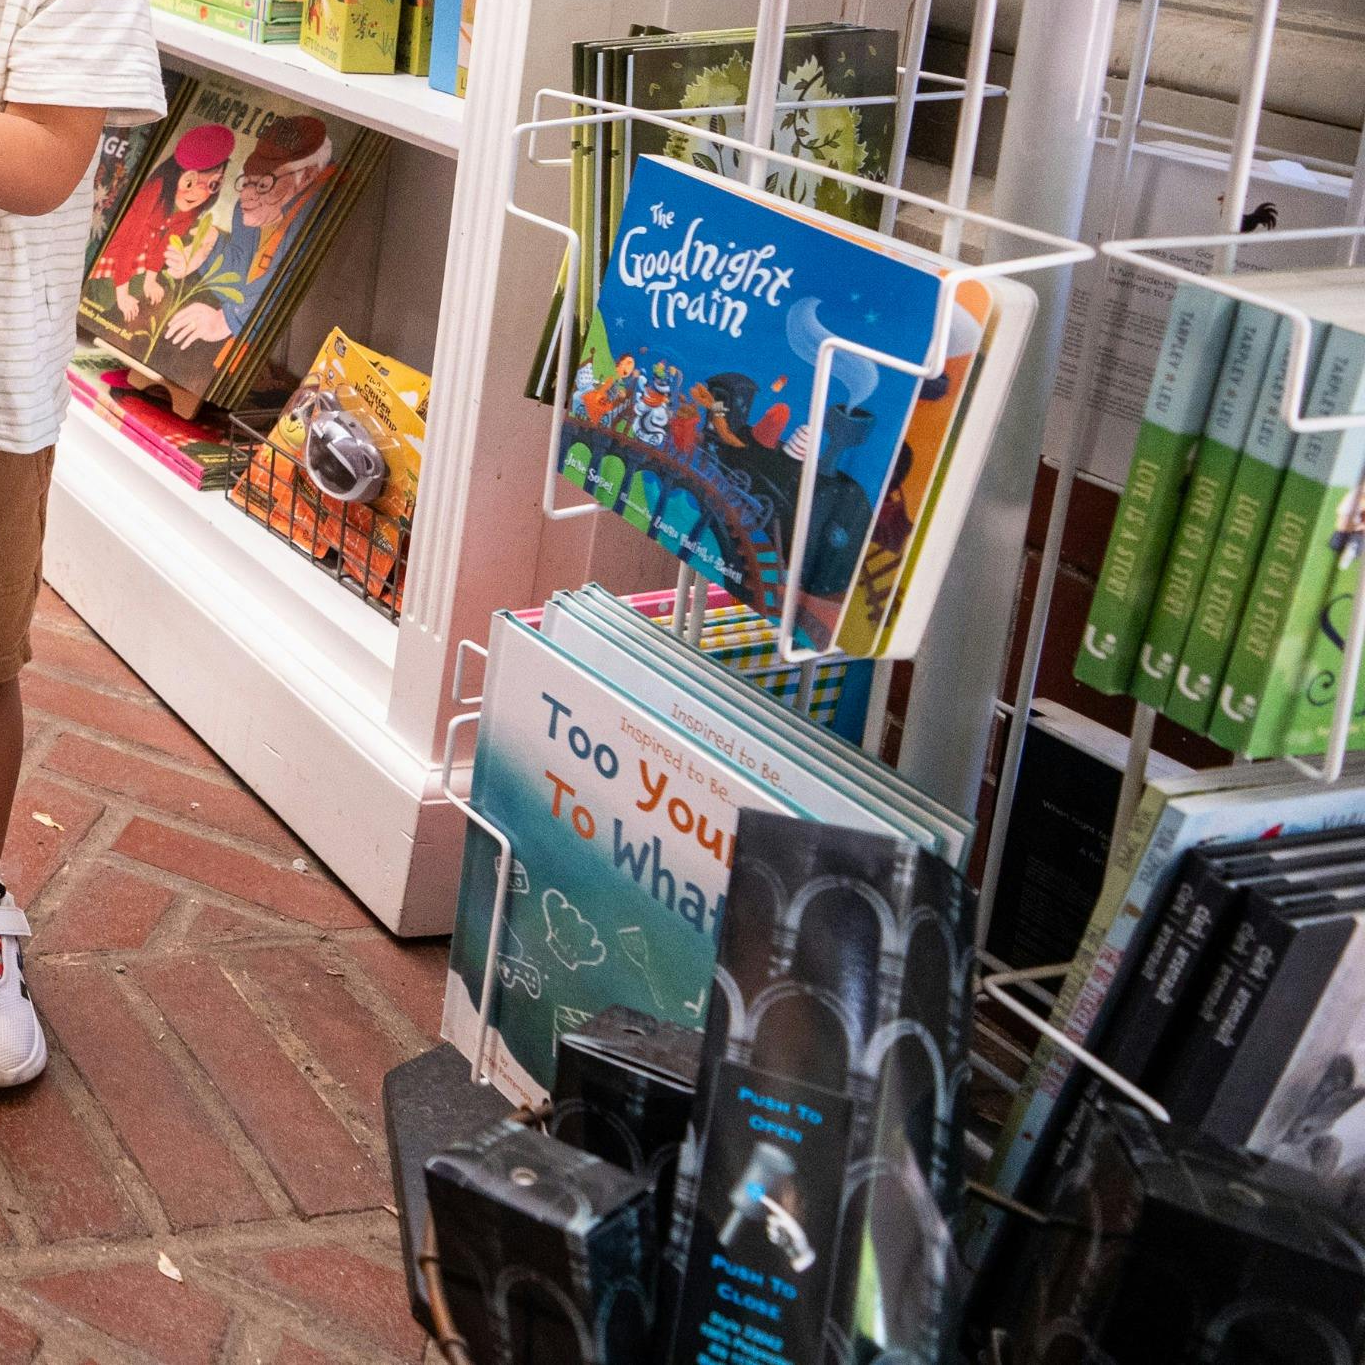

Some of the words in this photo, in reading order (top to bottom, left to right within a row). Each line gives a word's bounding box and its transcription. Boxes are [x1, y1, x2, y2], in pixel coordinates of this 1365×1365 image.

[103, 135, 131, 158] GE
[649, 201, 675, 228] The
[618, 218, 794, 308] Goodnight
[646, 278, 749, 339] Train
[1167, 310, 1194, 371] TARPLEY
[1229, 326, 1258, 390] TARPLEY
[1155, 380, 1172, 415] LEU
[1215, 397, 1233, 432] LEU
[1256, 417, 1273, 450] LEU
[541, 691, 620, 781] Too
[620, 716, 684, 772] Inspired
[686, 762, 705, 785] to
[671, 702, 736, 757] Inspired
[738, 748, 756, 771] to
[544, 769, 596, 840] To
[635, 758, 739, 870] You
[737, 1084, 791, 1116] PUSH
[797, 1103, 825, 1126] TO
[748, 1114, 803, 1145] OPEN
[711, 1252, 767, 1288] PUSH
[771, 1274, 799, 1302] TO
[716, 1282, 783, 1322] CLOSE
